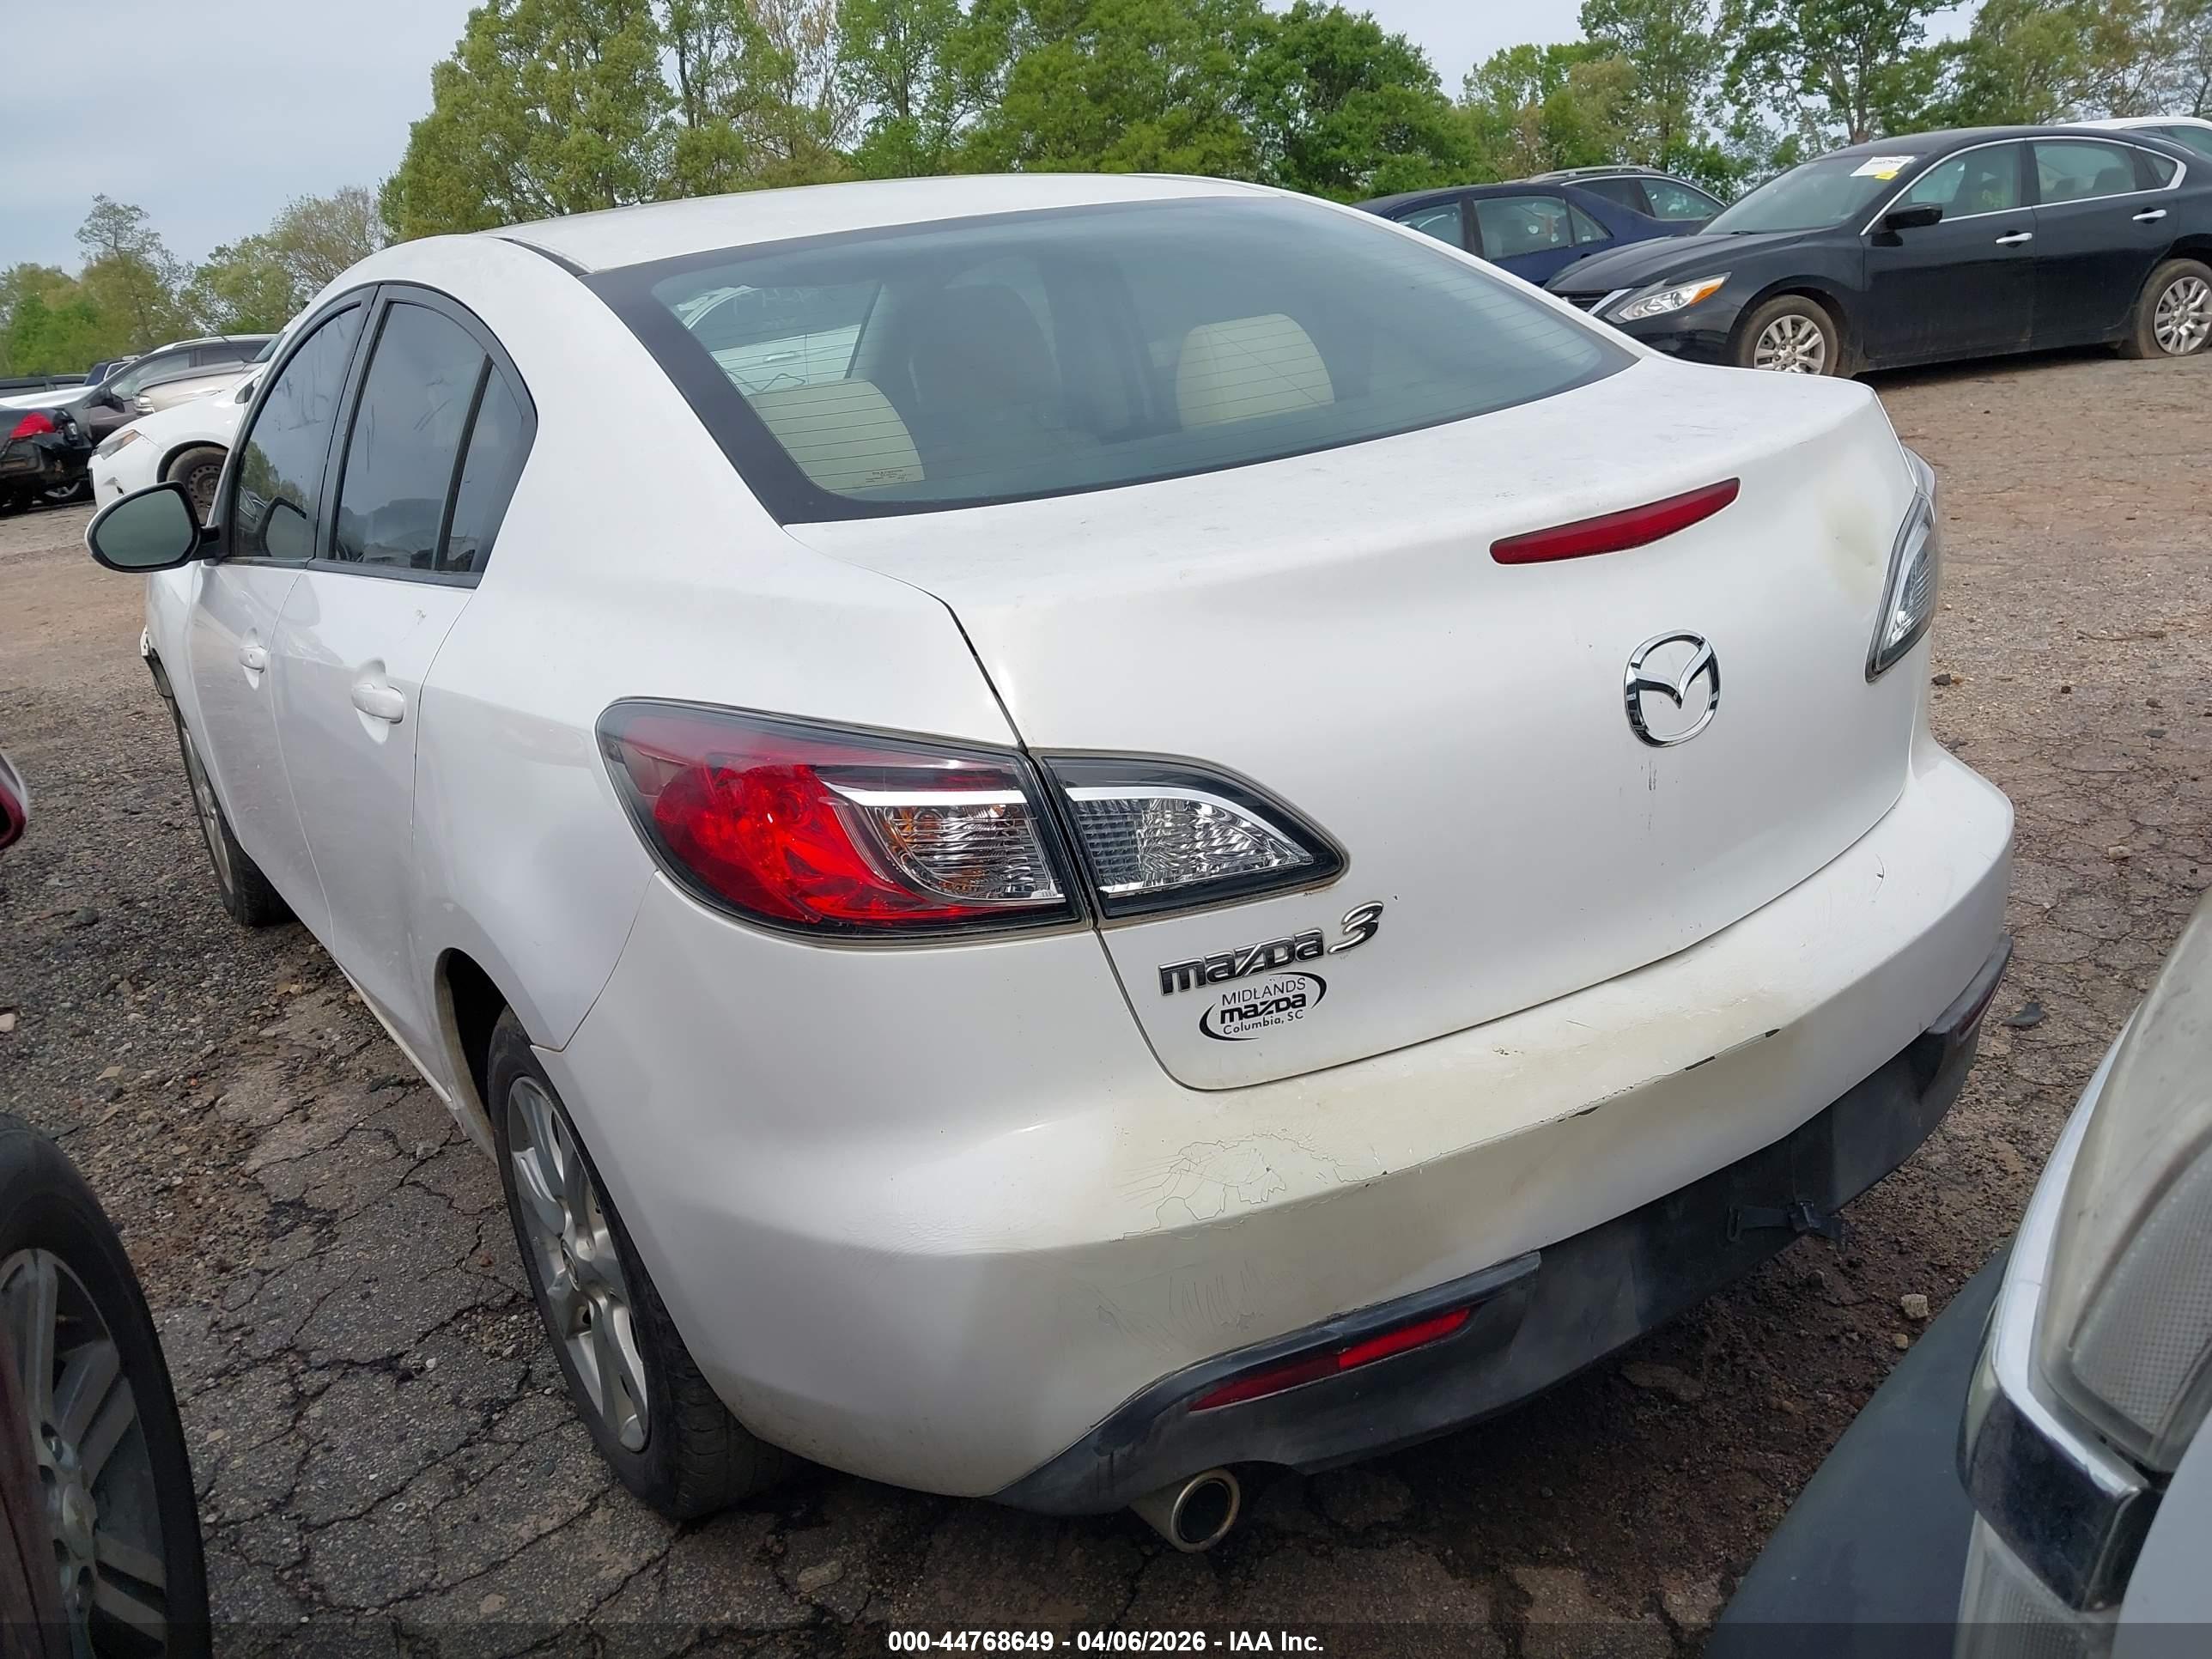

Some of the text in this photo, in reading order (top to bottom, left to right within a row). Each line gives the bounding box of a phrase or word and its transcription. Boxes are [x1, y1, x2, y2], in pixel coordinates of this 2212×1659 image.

[1327, 901, 1384, 955] 3
[1222, 977, 1306, 1006] MIDLANDS
[1223, 1010, 1304, 1035] Columbia, SC
